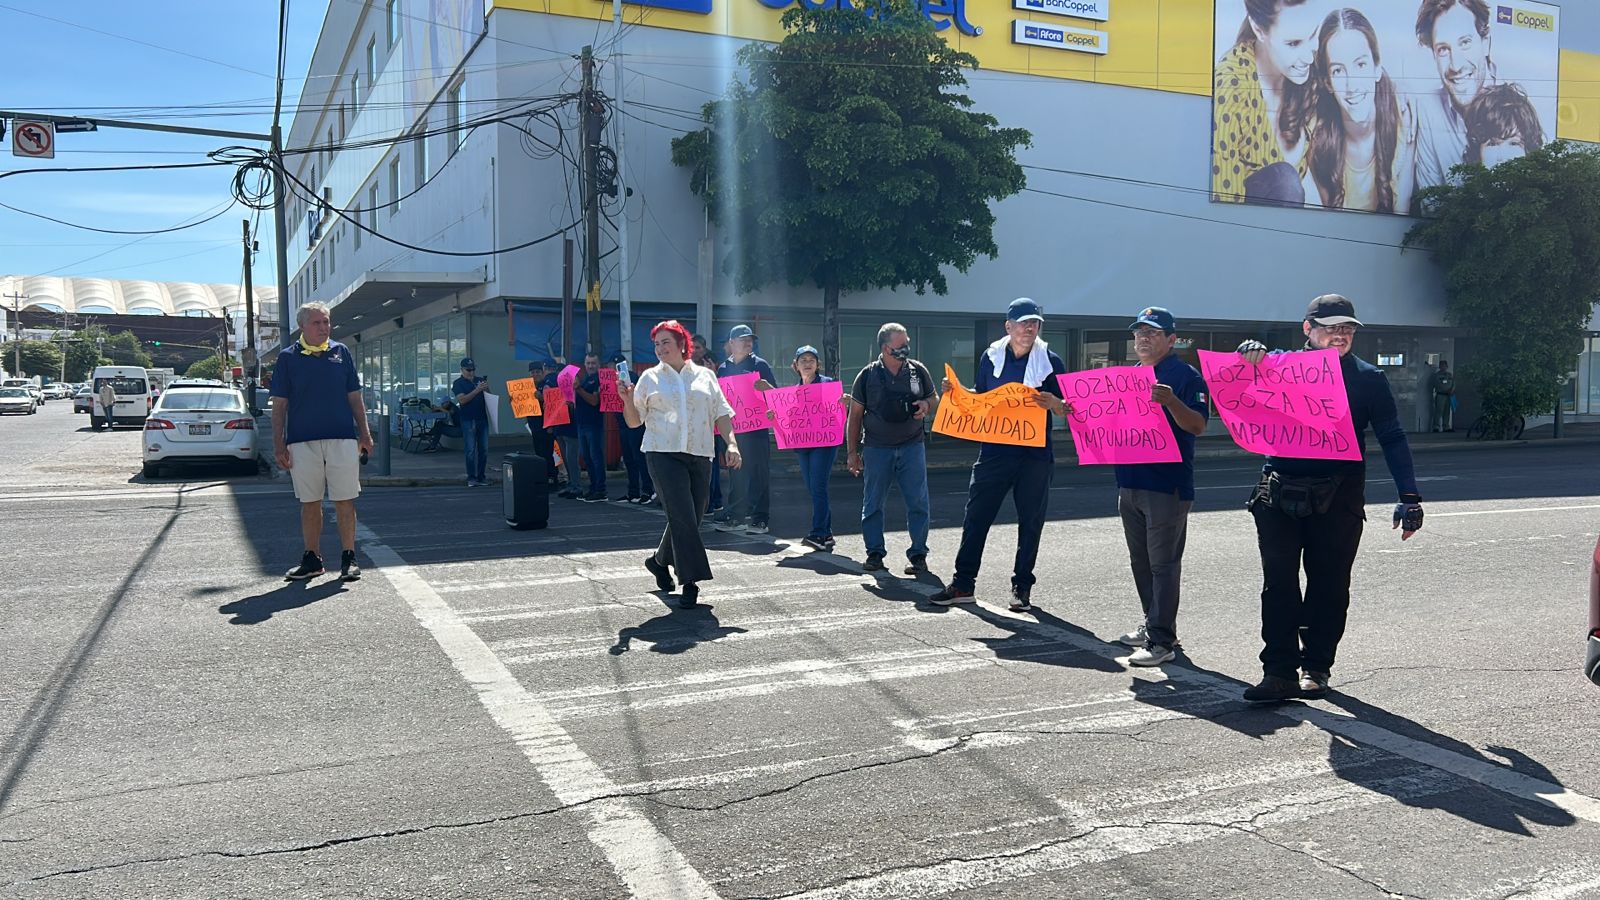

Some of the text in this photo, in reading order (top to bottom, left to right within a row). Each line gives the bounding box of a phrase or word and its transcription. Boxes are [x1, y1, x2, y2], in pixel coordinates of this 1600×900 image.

[1516, 12, 1549, 29] Coppel
[1040, 30, 1096, 45] Afore Coppel
[771, 387, 813, 409] PROFE
[1005, 397, 1037, 409] DE
[1216, 388, 1340, 420] GOZA DE
[744, 406, 764, 418] DE
[1069, 396, 1160, 424] GOZA DE
[779, 416, 837, 429] GOZA DE
[941, 408, 1036, 441] IMPUNIDAD
[782, 431, 837, 448] IMPUNIDAD
[1077, 426, 1167, 453] IMPUNIDAD
[1231, 421, 1351, 453] MPUNIDAD
